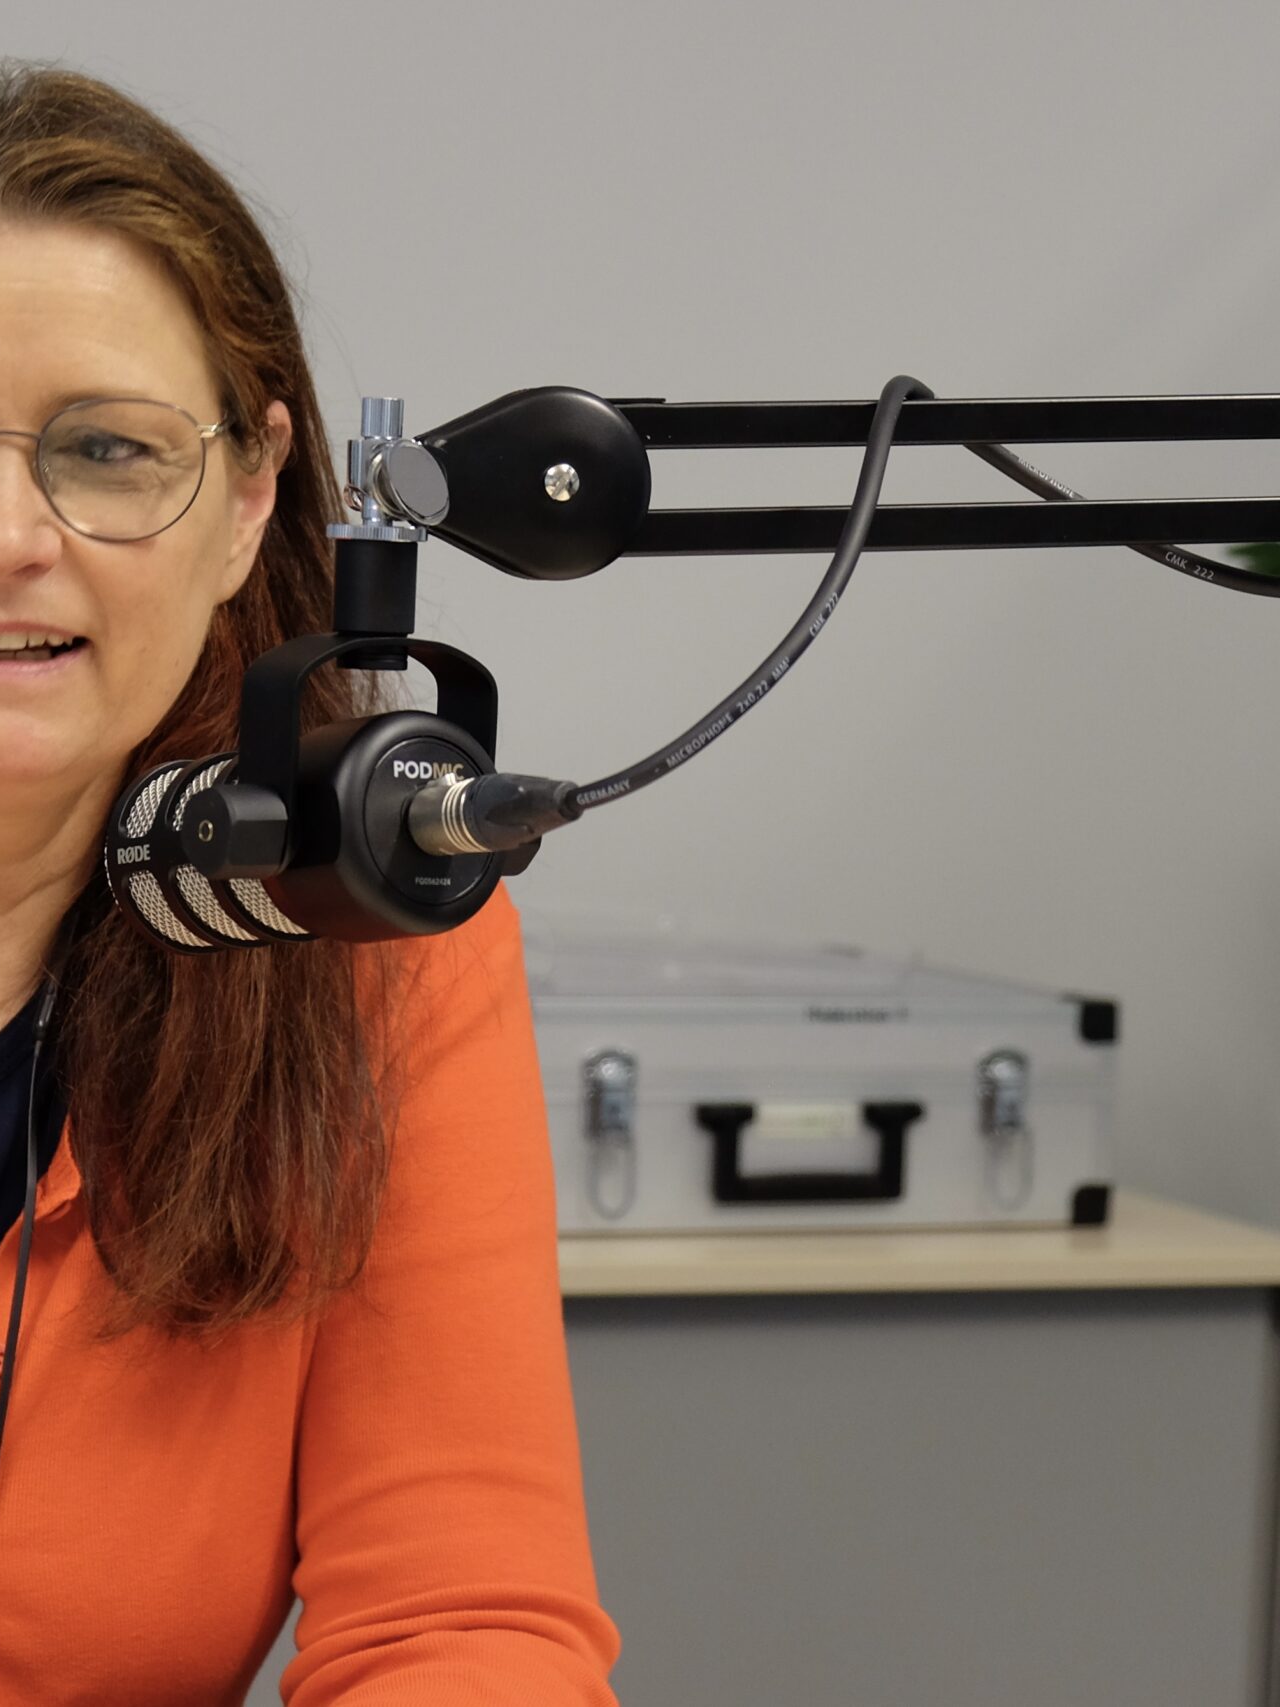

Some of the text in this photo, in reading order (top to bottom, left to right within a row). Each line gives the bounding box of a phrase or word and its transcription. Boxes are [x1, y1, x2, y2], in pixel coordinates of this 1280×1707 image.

[1165, 551, 1215, 582] CMK 222
[576, 778, 631, 806] GERMANY
[666, 711, 734, 768] MICROPHONE
[809, 614, 827, 637] CMK
[393, 760, 465, 780] PODMIC
[117, 844, 151, 865] RØDE
